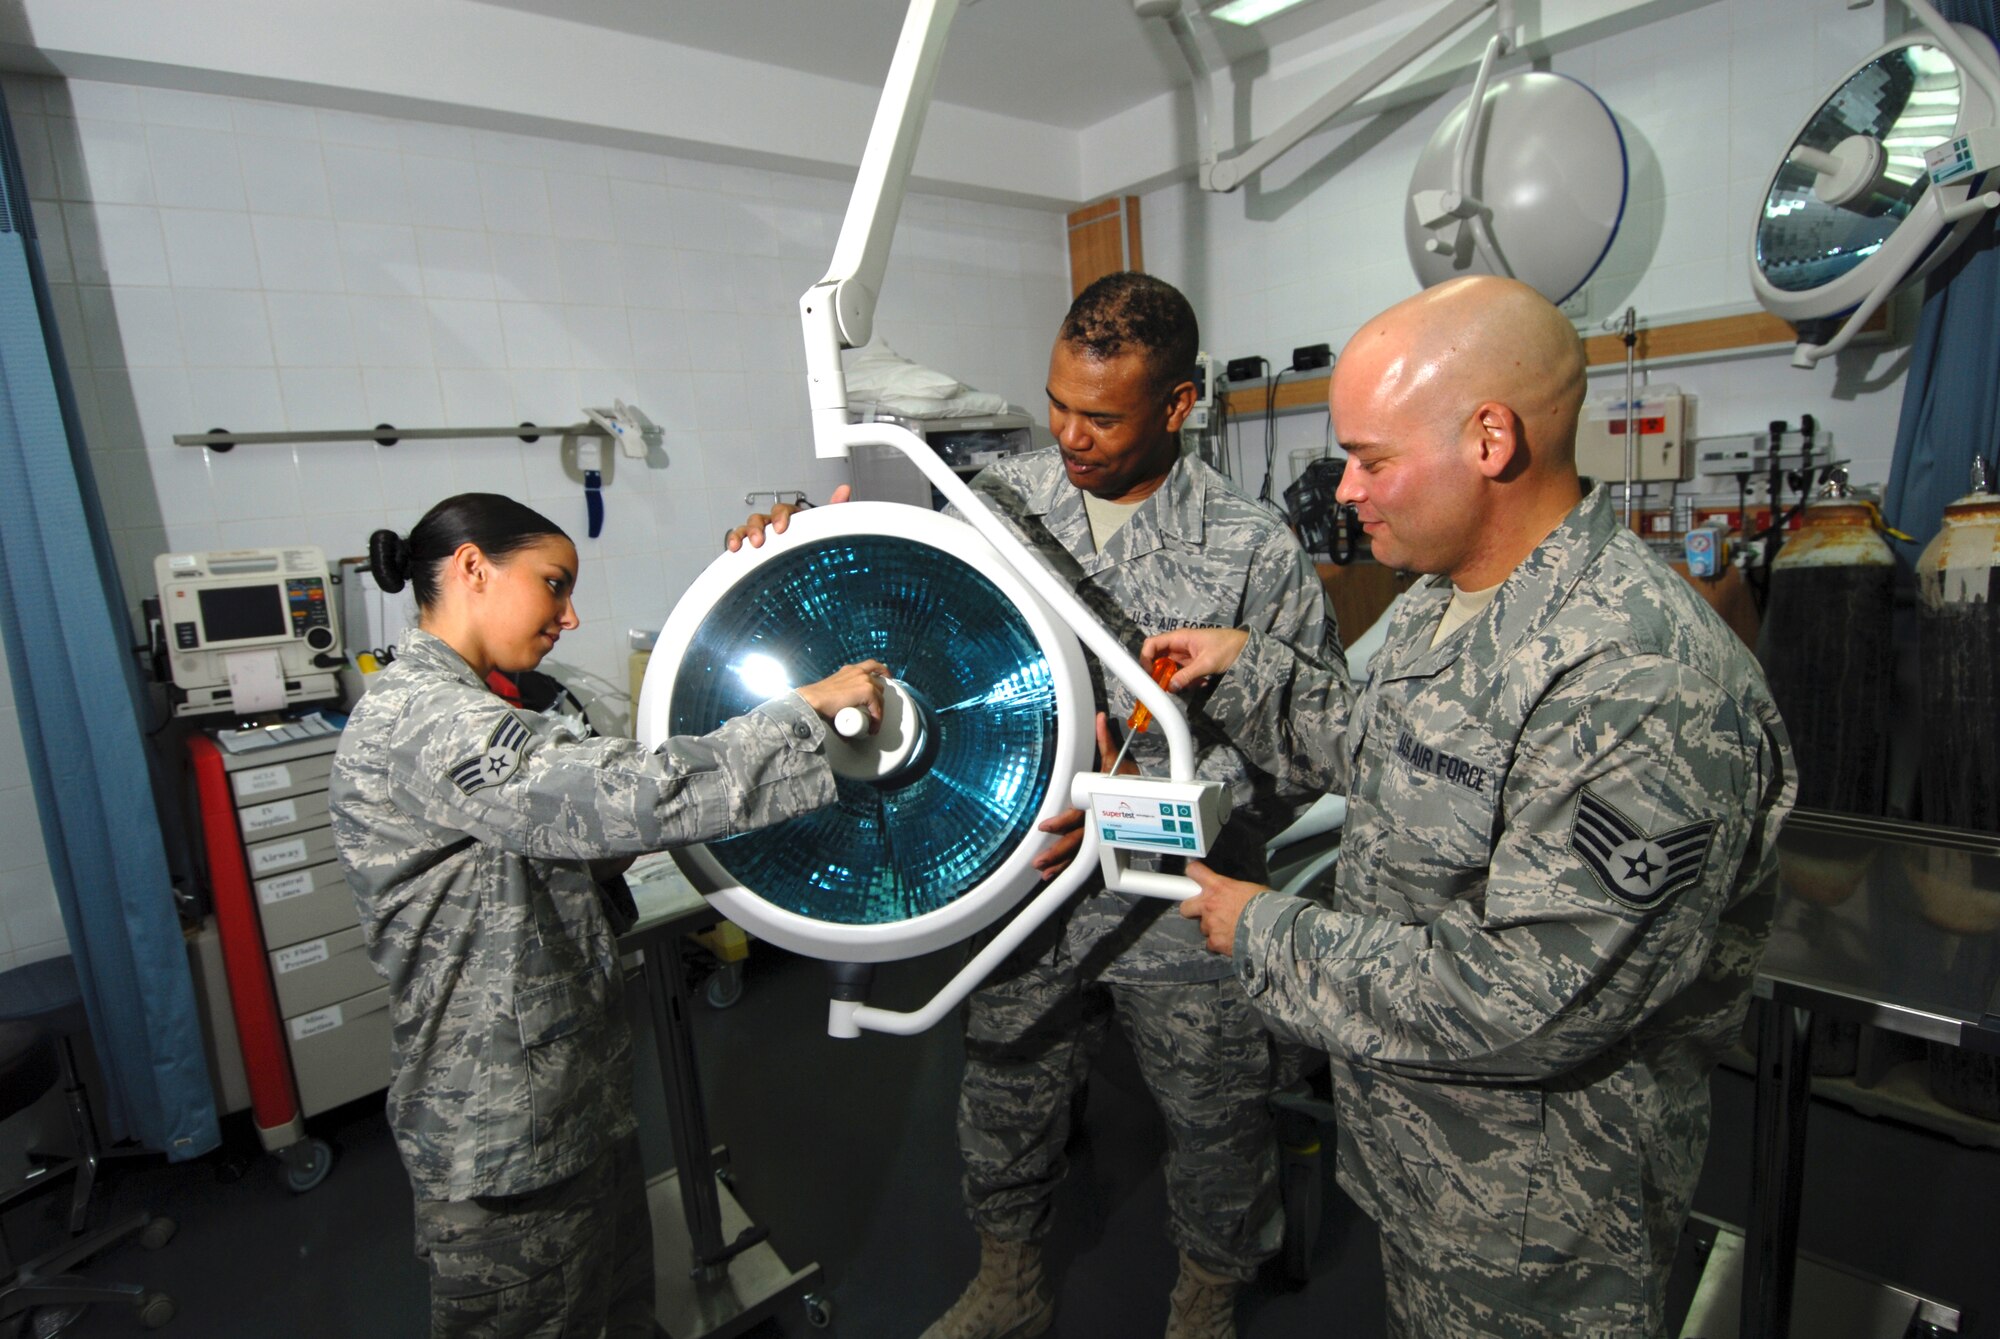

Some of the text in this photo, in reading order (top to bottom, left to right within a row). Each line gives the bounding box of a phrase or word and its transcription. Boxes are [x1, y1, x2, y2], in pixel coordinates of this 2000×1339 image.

[1132, 610, 1153, 627] U.S.
[1158, 616, 1178, 631] AIR
[1409, 742, 1433, 771] AIR
[1437, 751, 1487, 792] FORCE
[1102, 810, 1135, 819] supertest
[260, 850, 299, 864] Airway
[268, 875, 304, 891] Central
